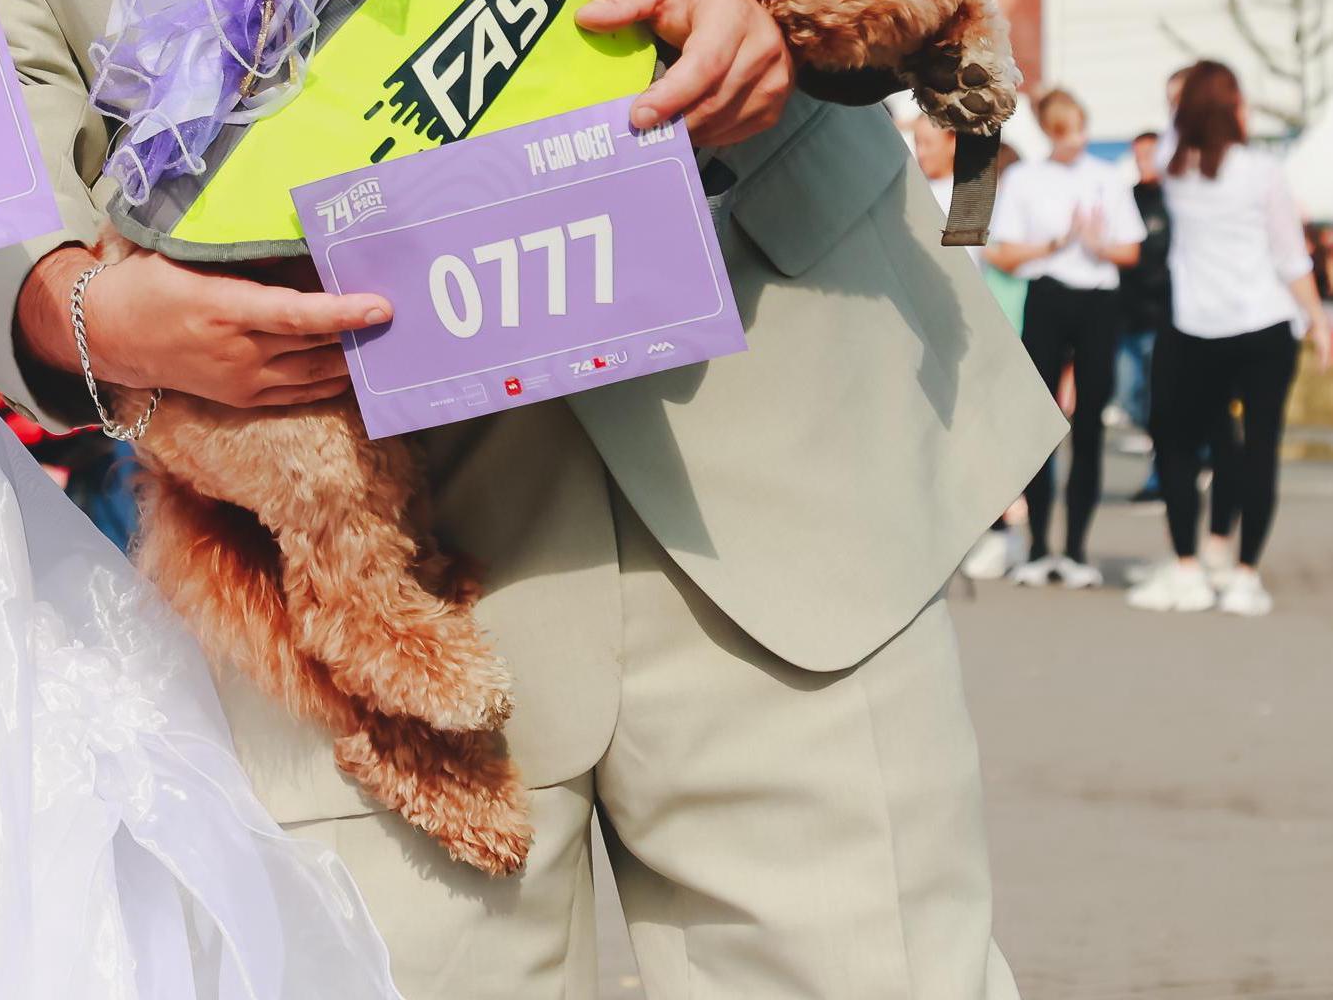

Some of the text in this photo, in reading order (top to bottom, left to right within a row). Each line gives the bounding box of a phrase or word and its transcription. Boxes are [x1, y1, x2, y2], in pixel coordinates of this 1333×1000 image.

[524, 141, 547, 176] 74
[542, 133, 577, 171] САП
[573, 122, 616, 162] ФЕСТ
[317, 195, 354, 233] 74
[350, 181, 380, 201] САП
[428, 214, 614, 338] 0777
